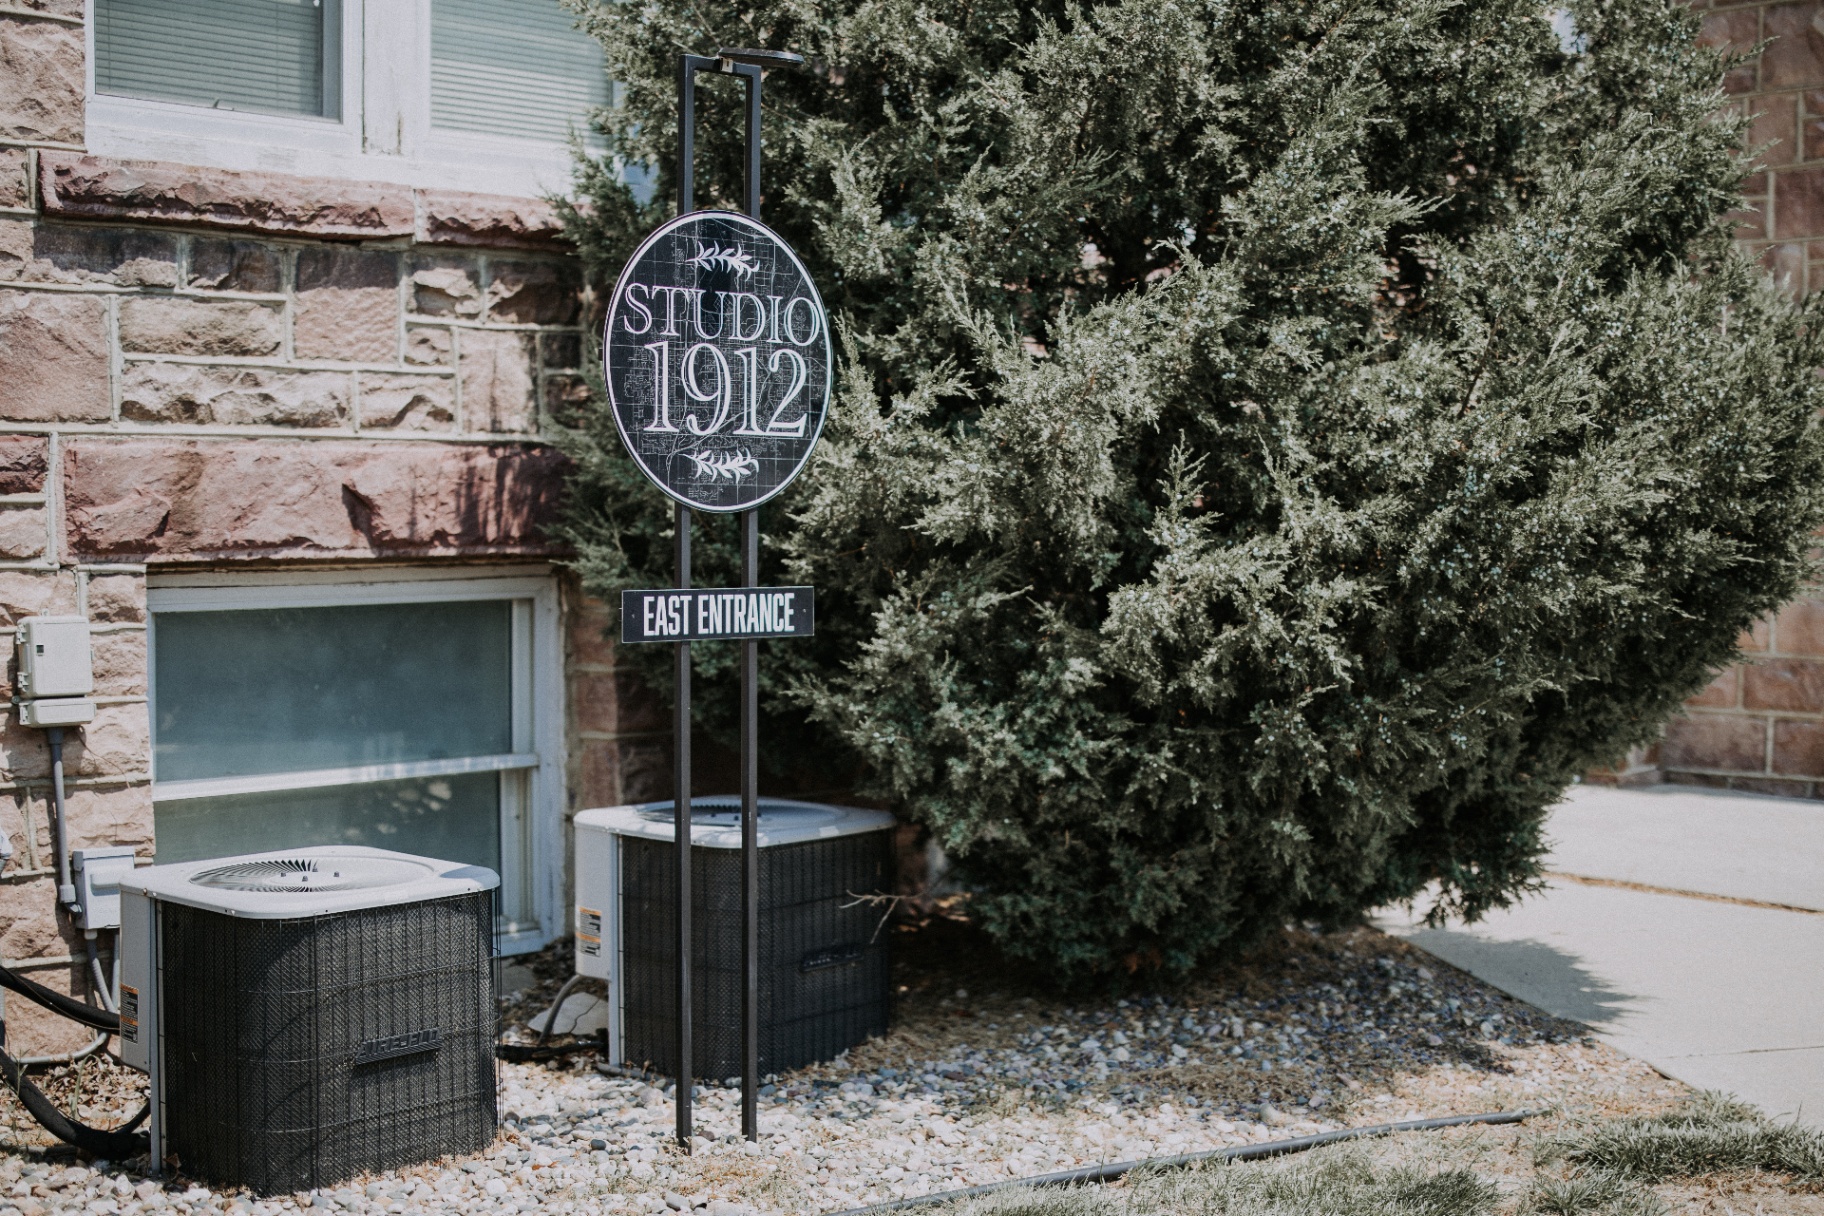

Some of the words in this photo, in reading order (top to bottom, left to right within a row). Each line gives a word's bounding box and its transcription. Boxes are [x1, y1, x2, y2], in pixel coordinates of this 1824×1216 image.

[623, 283, 820, 346] STUDIO
[643, 341, 808, 437] 1912
[643, 595, 692, 636] EAST
[698, 592, 795, 635] ENTRANCE
